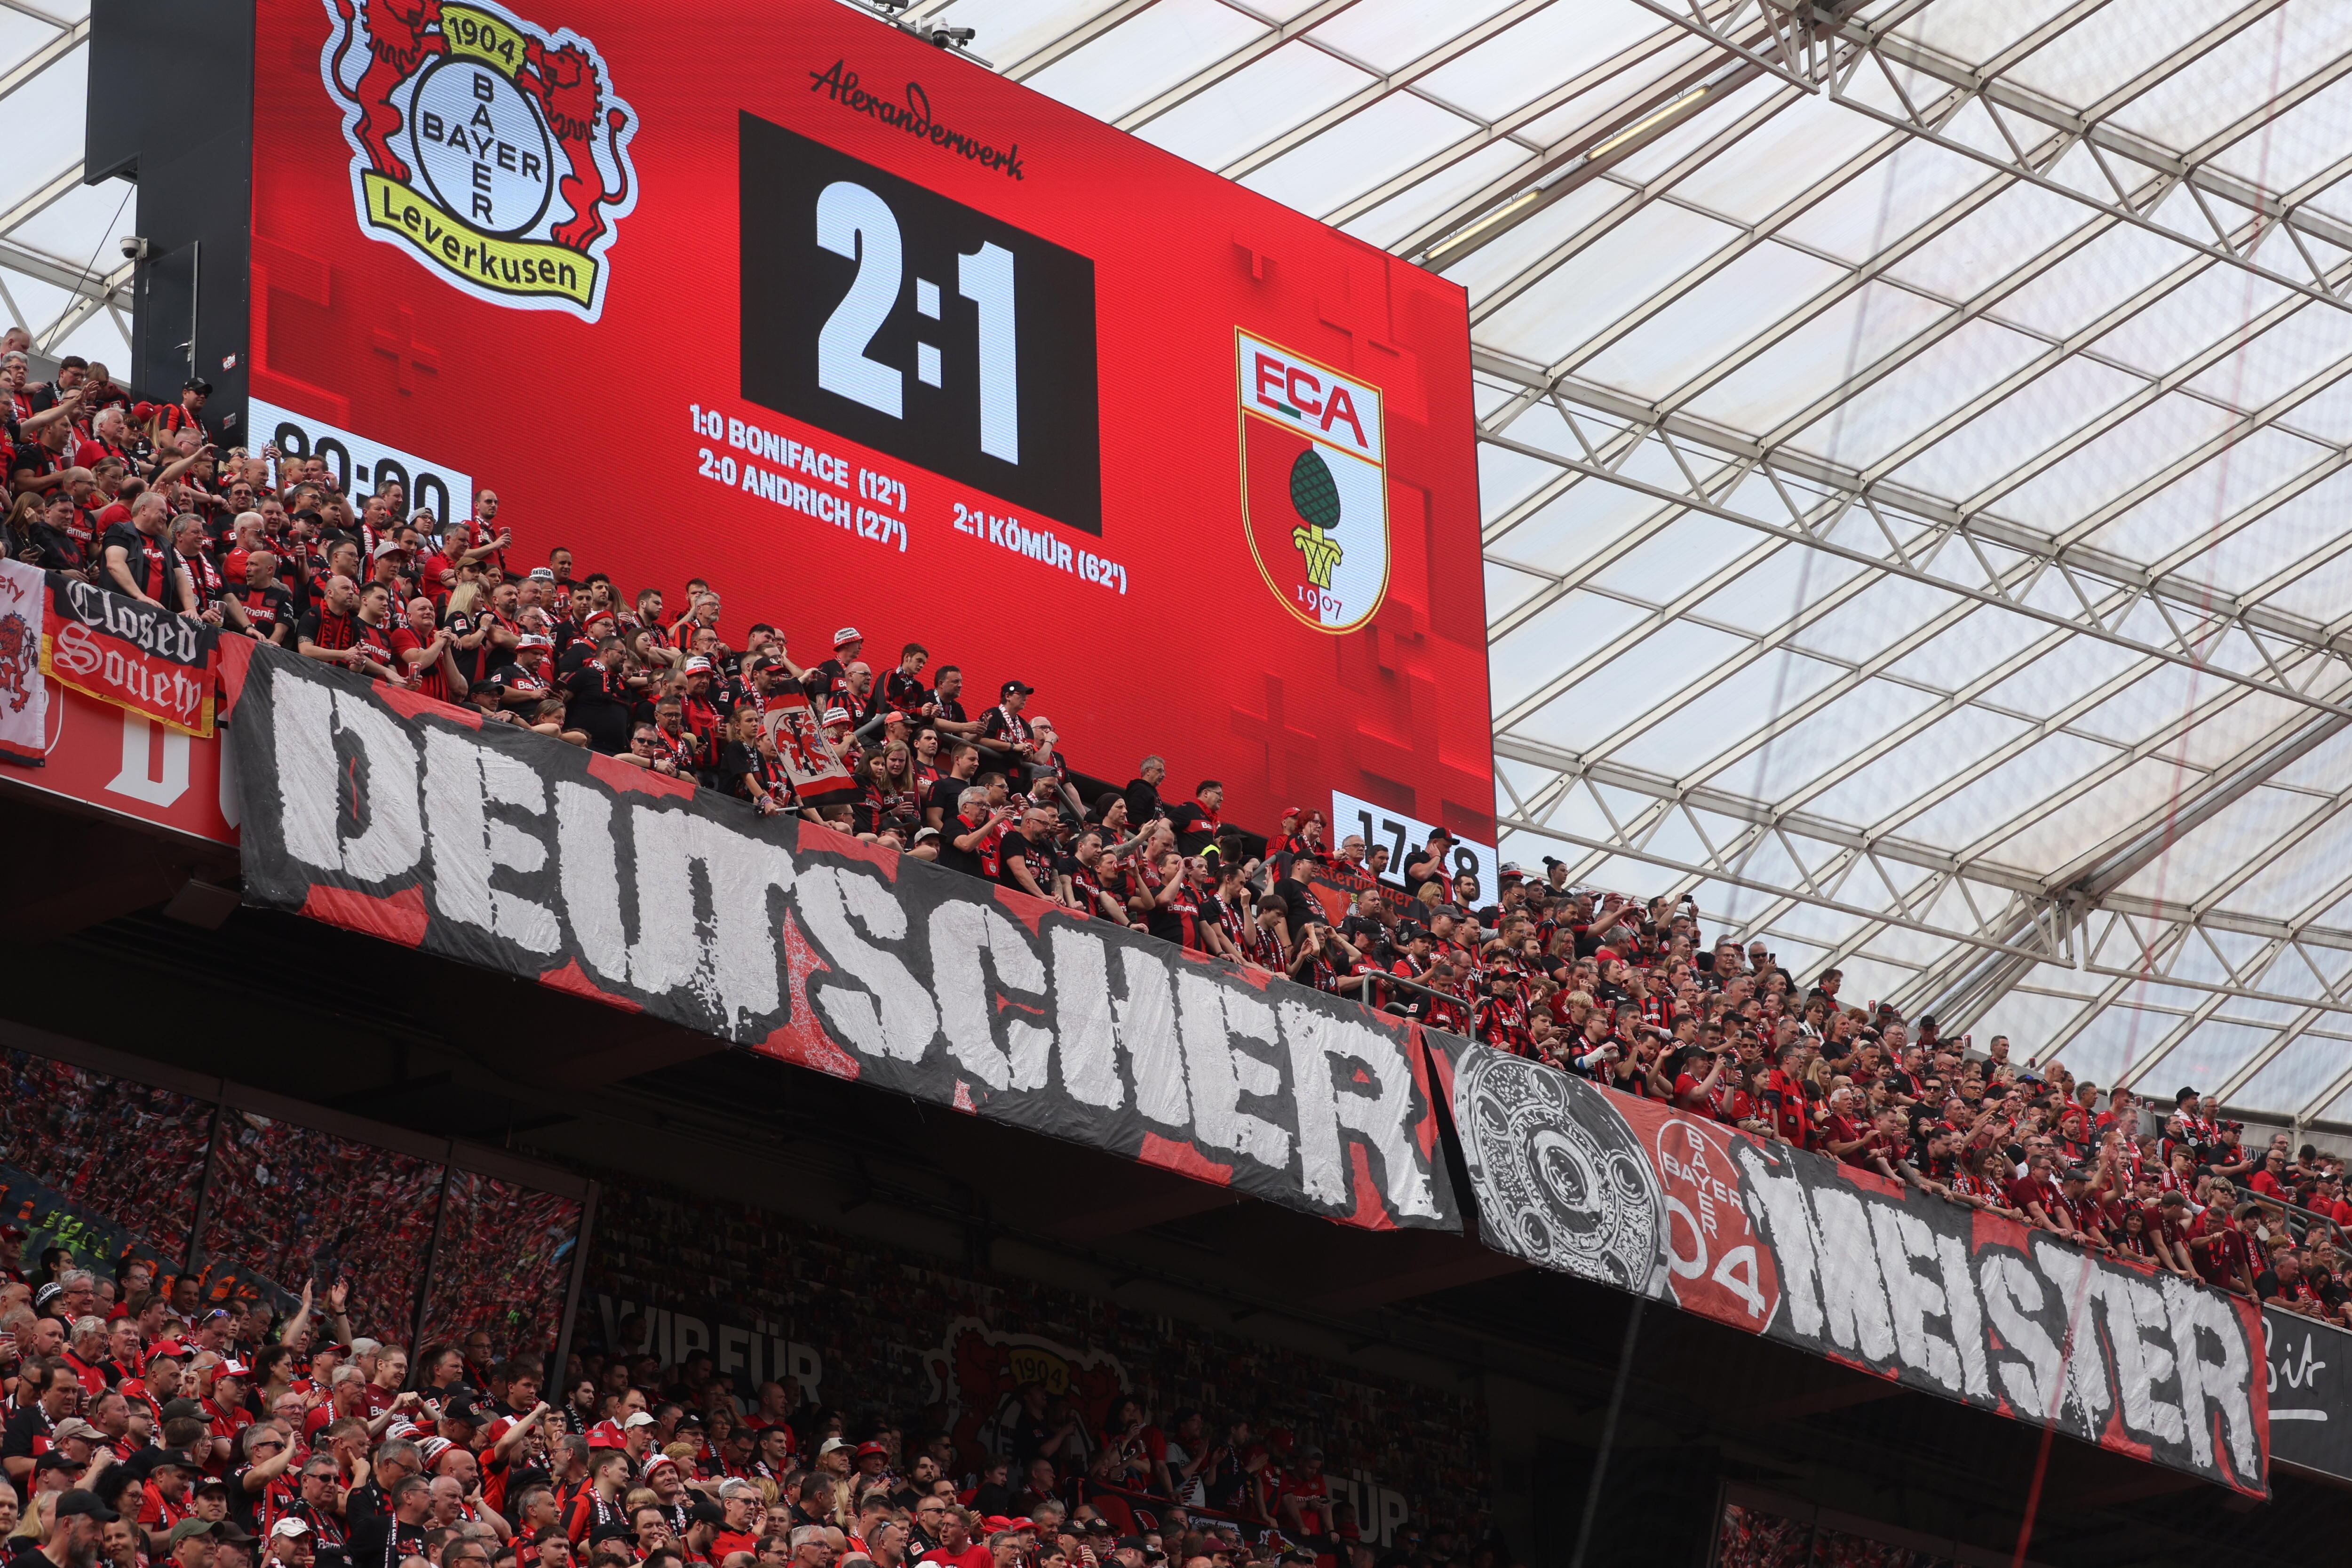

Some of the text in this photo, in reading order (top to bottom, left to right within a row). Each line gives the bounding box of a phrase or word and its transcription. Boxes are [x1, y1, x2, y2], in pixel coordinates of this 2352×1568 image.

[449, 16, 514, 64] 1904
[423, 111, 541, 183] BAYER
[470, 72, 494, 225] BAYER
[809, 60, 1024, 181] Alexanderwerk
[383, 185, 577, 291] Leverkusen
[817, 181, 1018, 465] 2:1
[1255, 351, 1369, 449] FCA
[690, 403, 907, 512] 1:0 BONIFACE (12')
[699, 448, 907, 552] 2:0 ANDRICH (27')
[67, 526, 93, 541] armeni
[530, 567, 552, 580] ERKUSEN
[953, 503, 1127, 595] 2:1 KÖMÜR (62')
[66, 579, 197, 662] Closed
[193, 619, 207, 630] 1990
[242, 605, 275, 621] rmenia
[1297, 584, 1343, 621] 1907
[1358, 809, 1480, 901] 178
[271, 667, 1443, 1220] DEUTSCHER
[1662, 1151, 1746, 1215] BAYER
[1686, 1127, 1718, 1239] BAYER
[1665, 1195, 1765, 1319] 04
[1738, 1145, 2258, 1480] MEISTER
[1015, 1357, 1063, 1389] 1904
[318, 1538, 341, 1549] Barm
[330, 1529, 344, 1546] EASTPAK
